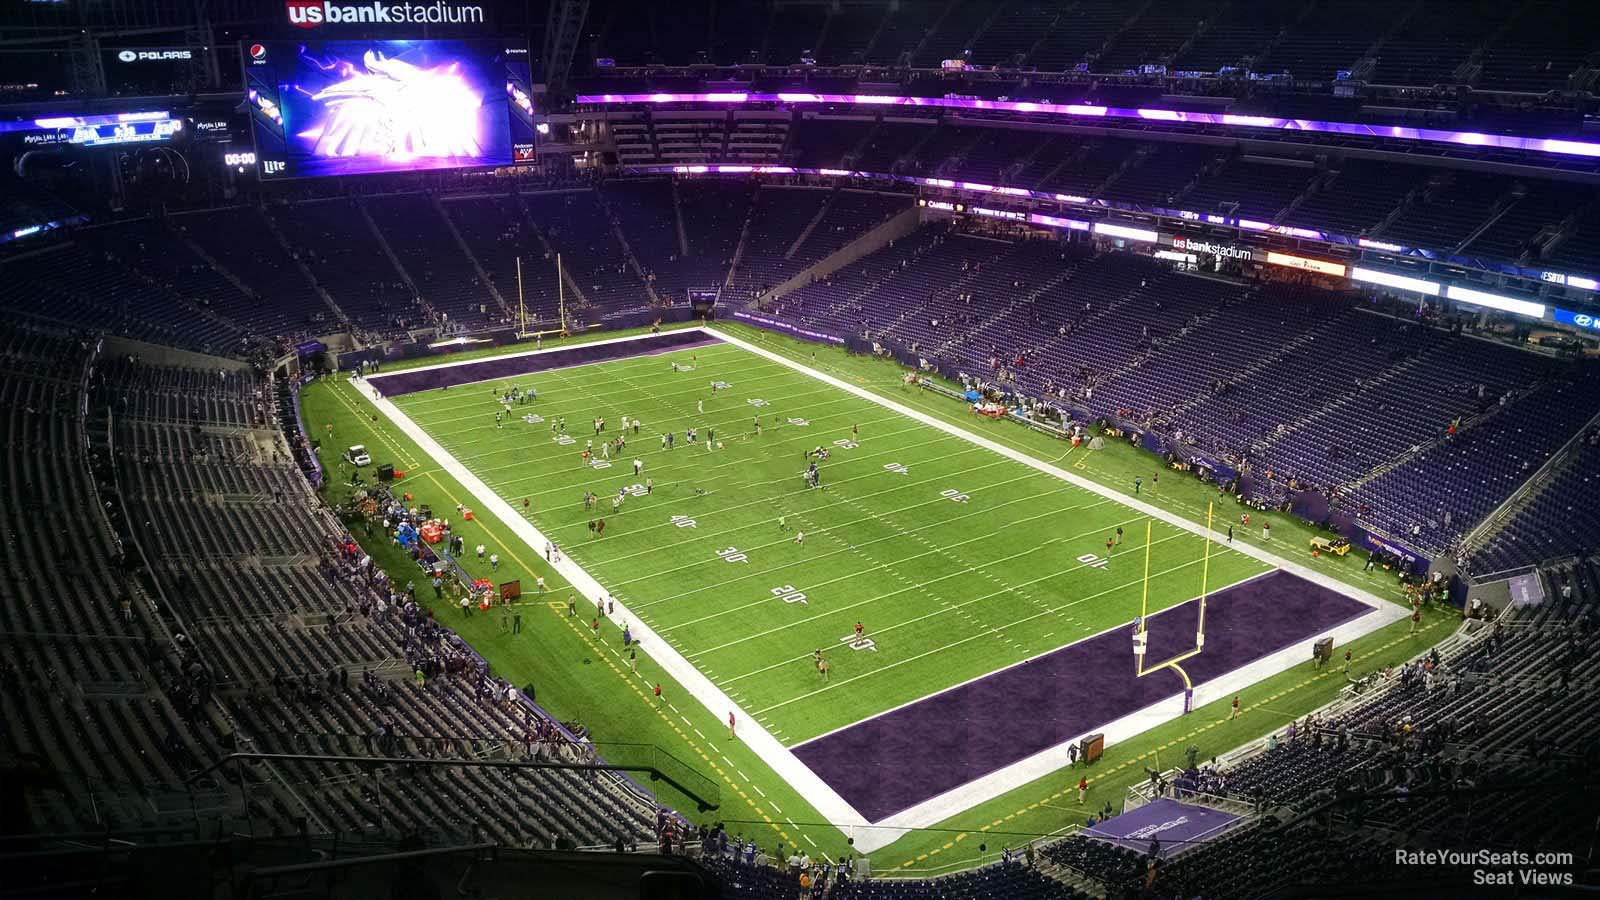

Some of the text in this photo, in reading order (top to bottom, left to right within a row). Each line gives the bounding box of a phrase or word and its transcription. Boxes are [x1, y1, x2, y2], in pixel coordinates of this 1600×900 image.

[138, 50, 192, 60] POLARIS
[224, 152, 256, 166] 00:00
[264, 160, 285, 173] Lite
[670, 516, 696, 528] 40
[715, 546, 748, 563] 30
[771, 585, 807, 603] 20
